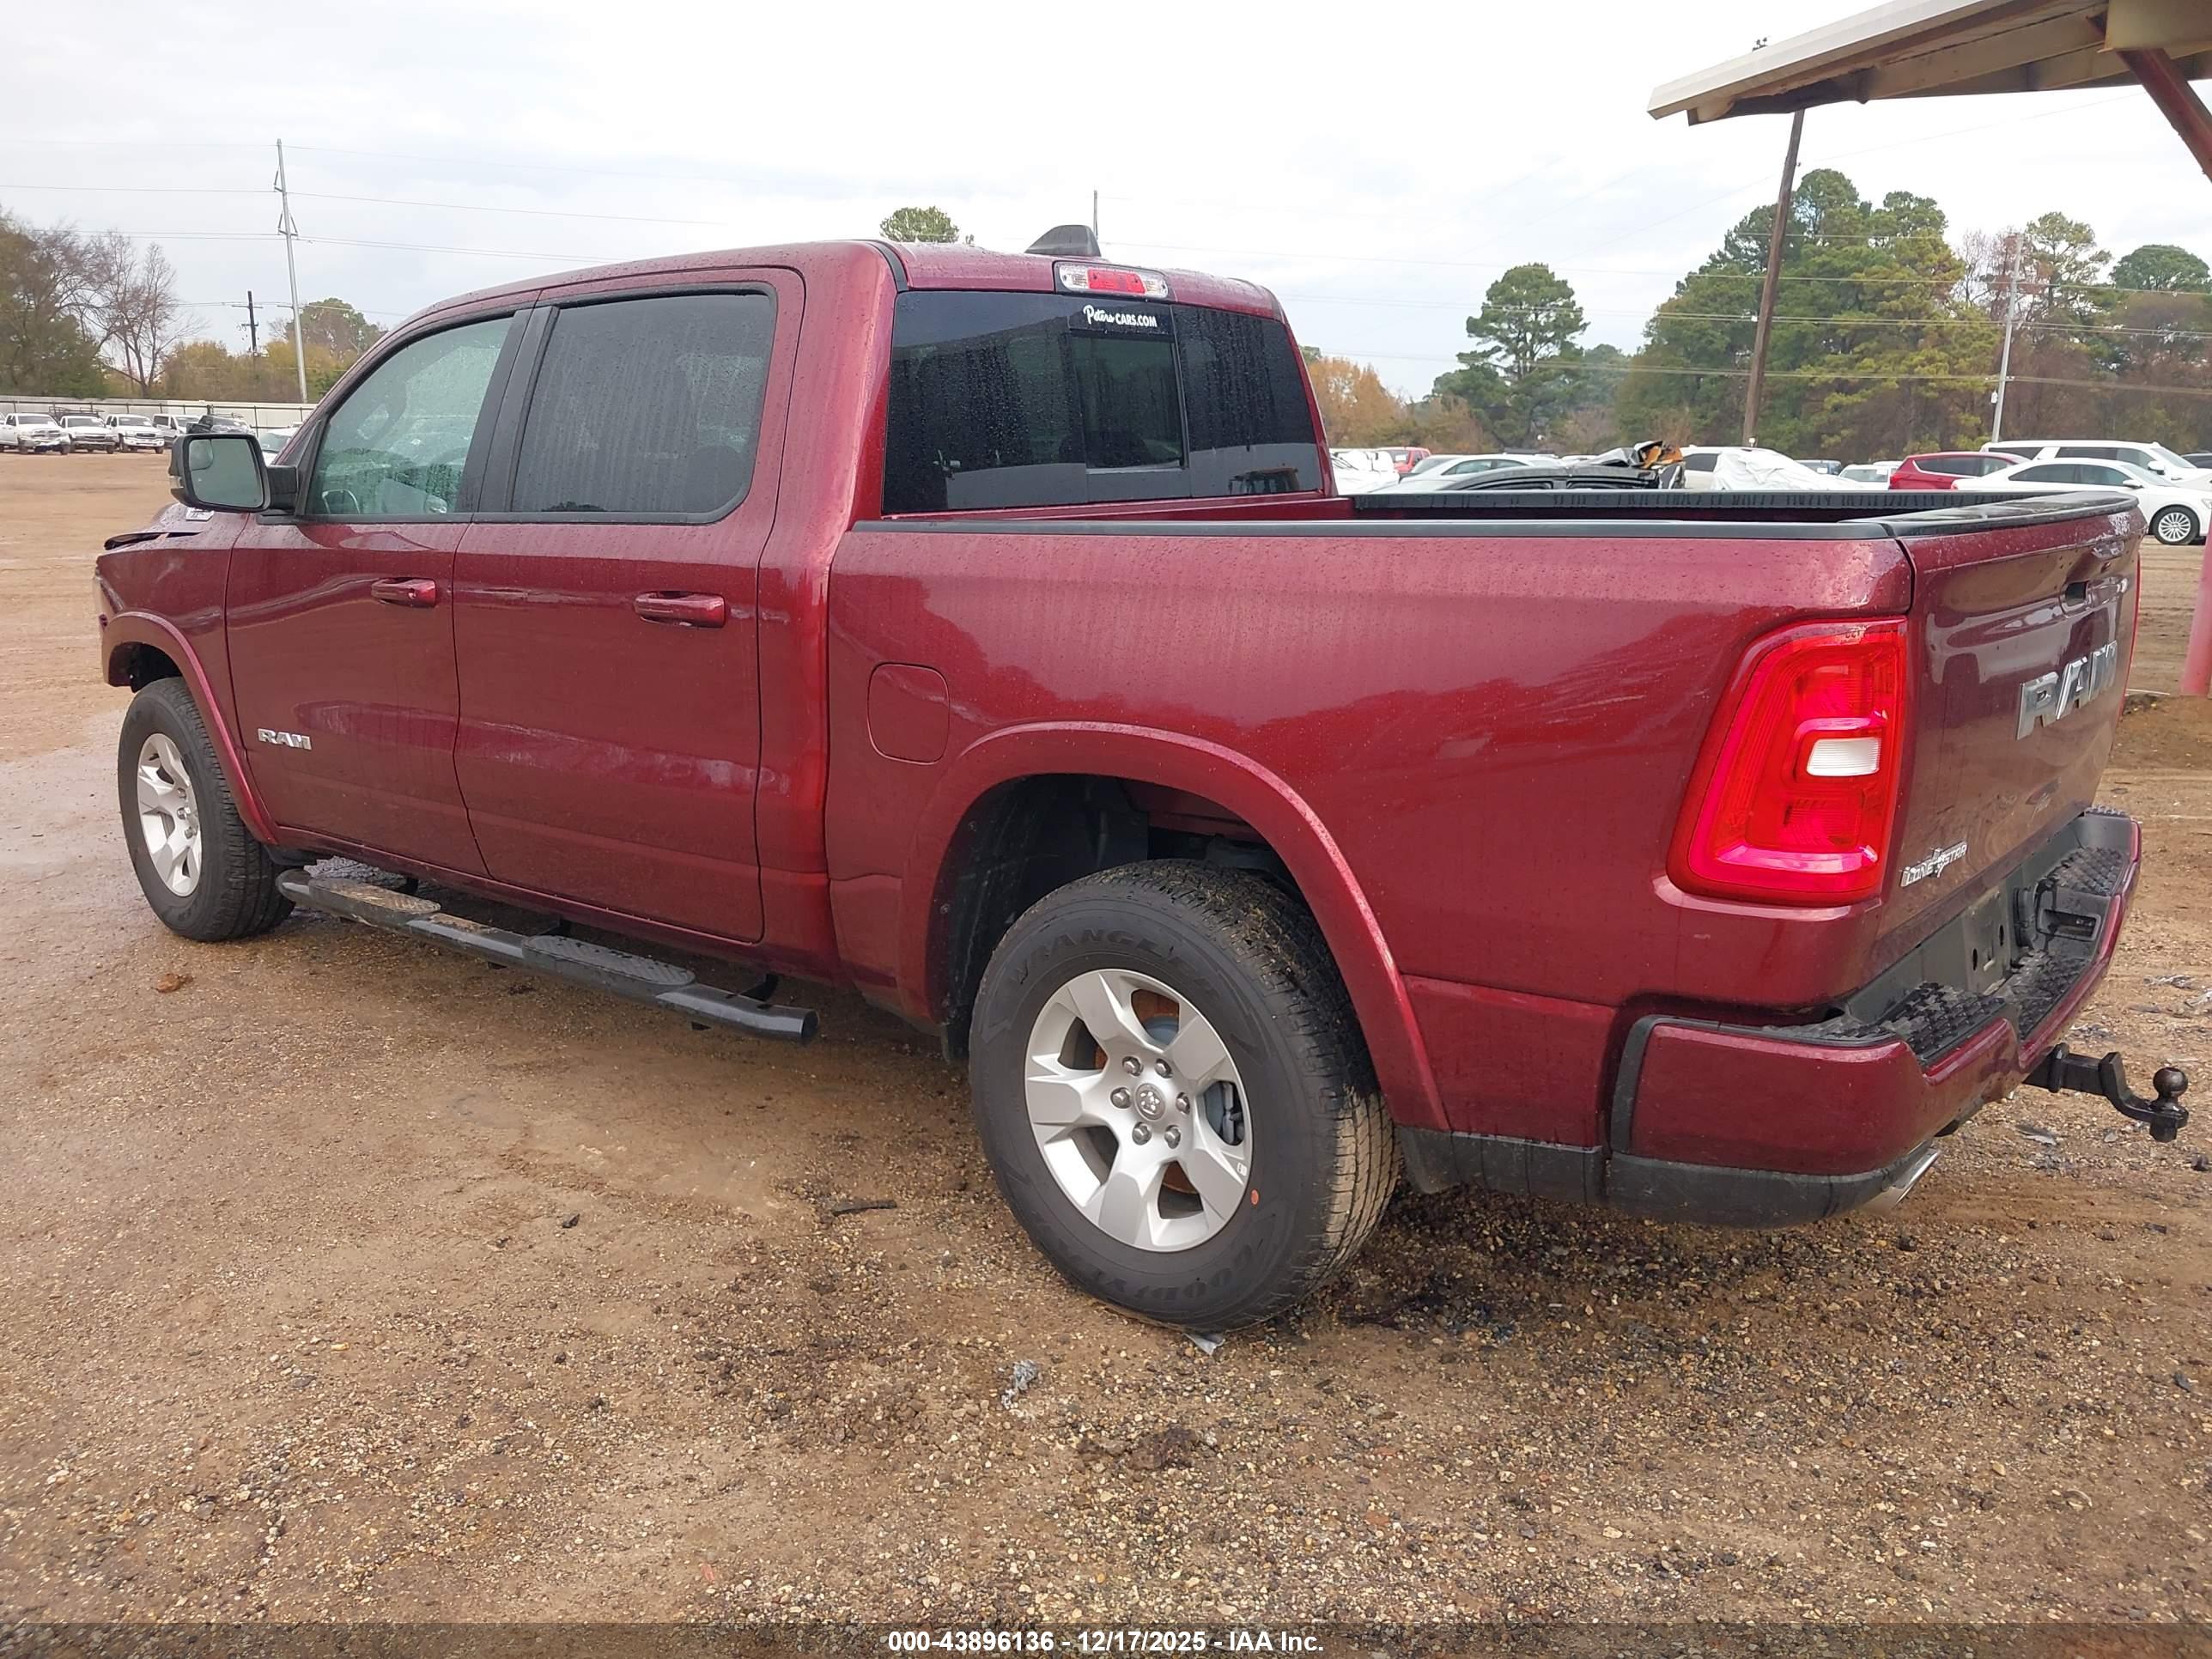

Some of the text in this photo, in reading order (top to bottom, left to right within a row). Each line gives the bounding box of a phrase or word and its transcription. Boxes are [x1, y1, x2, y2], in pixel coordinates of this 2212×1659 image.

[1115, 313, 1158, 327] CARS.COM
[2016, 640, 2118, 740] RAM
[257, 727, 313, 751] RAM
